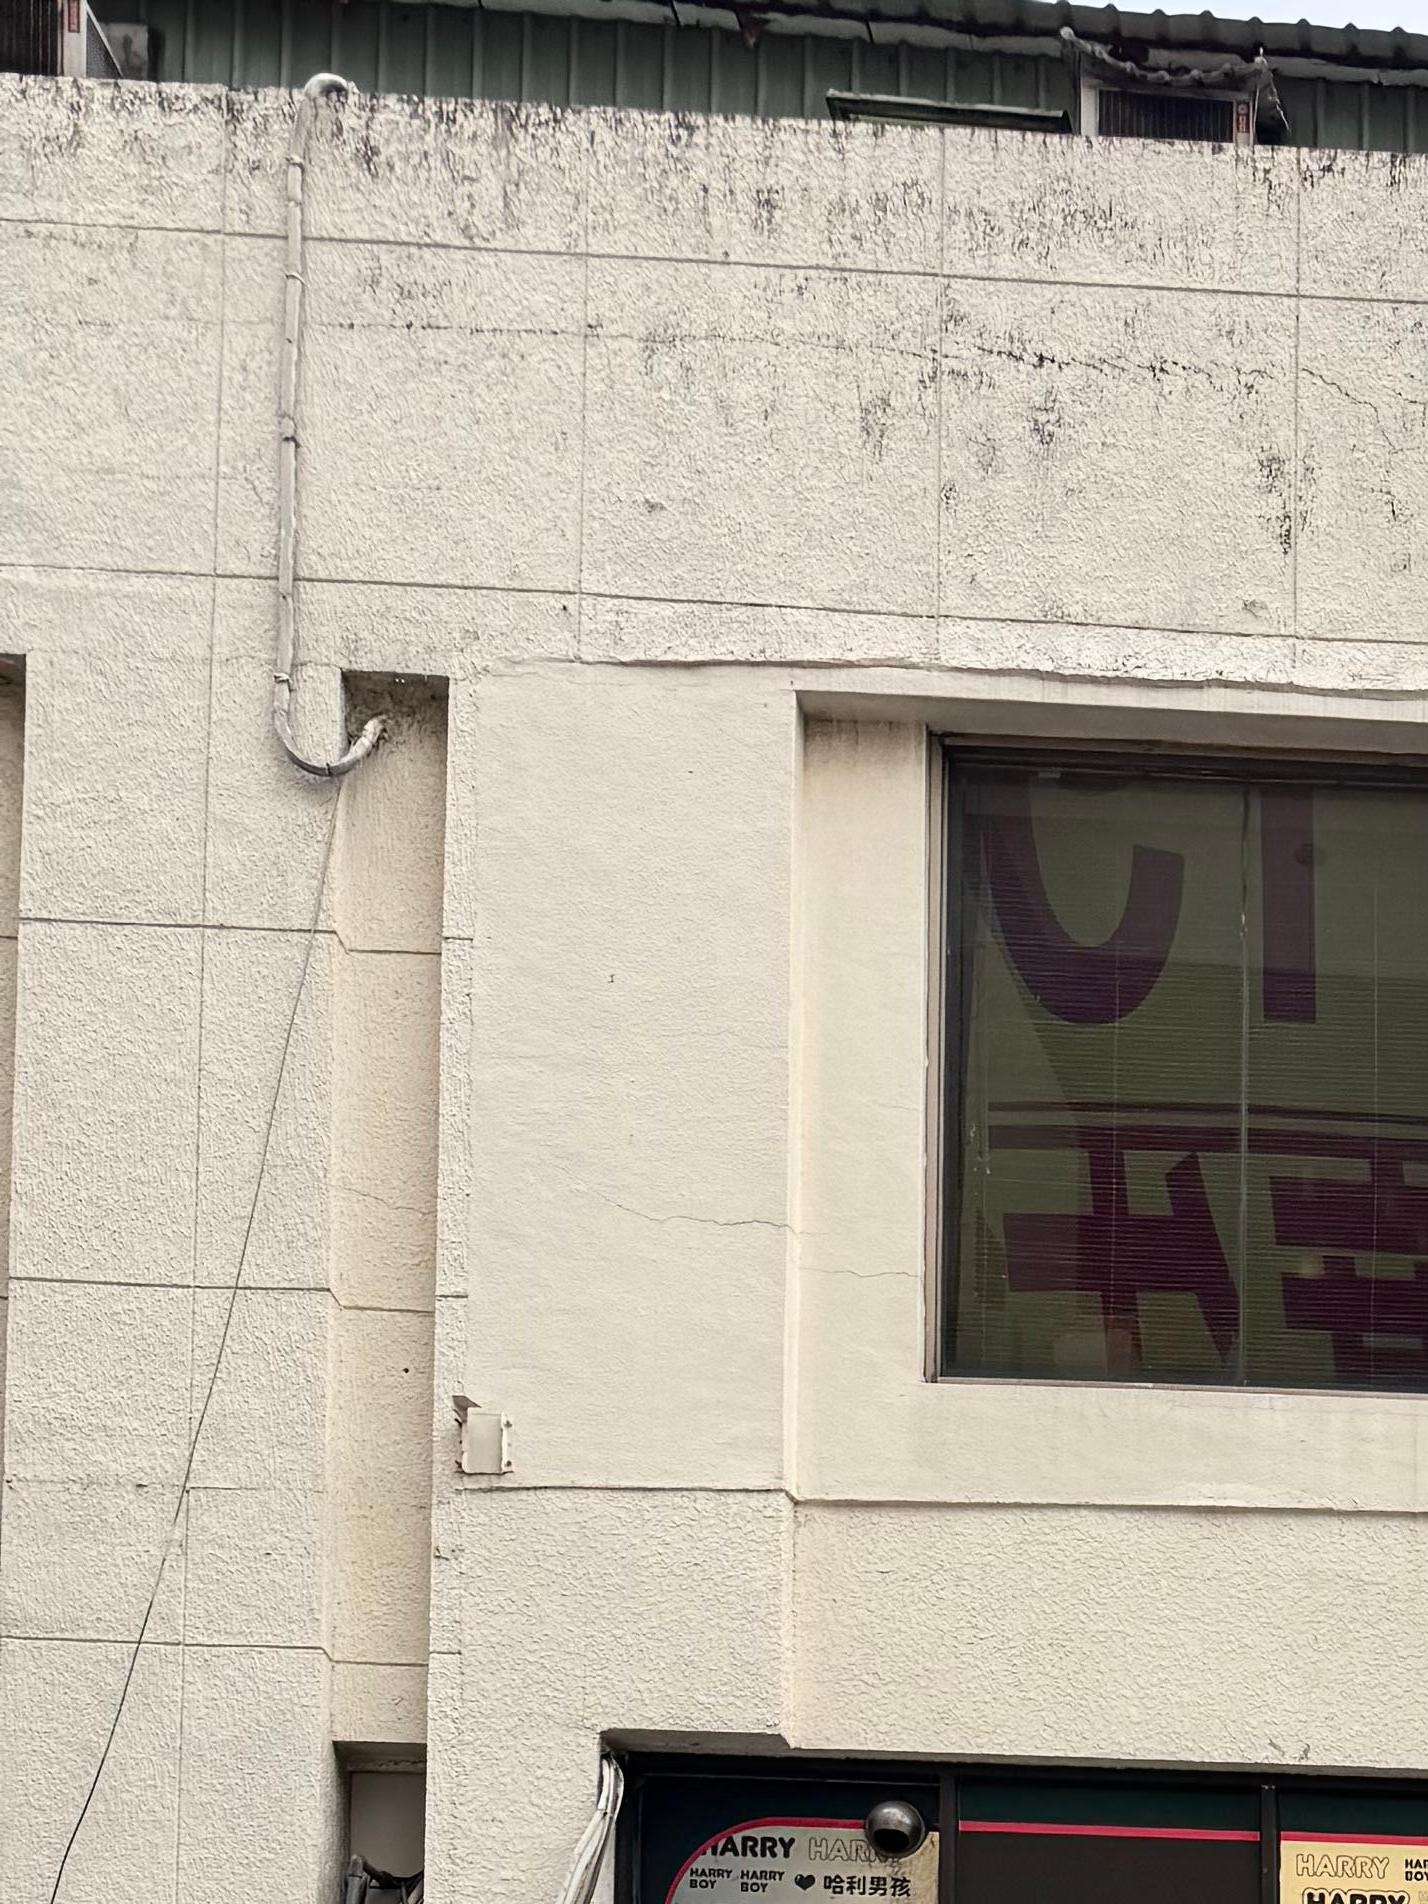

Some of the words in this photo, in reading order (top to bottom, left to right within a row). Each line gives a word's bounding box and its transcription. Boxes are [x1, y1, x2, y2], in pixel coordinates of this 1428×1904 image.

[1296, 1854, 1389, 1879] HARRY
[690, 1868, 732, 1879] HARRY
[740, 1870, 784, 1881] HARRY
[690, 1879, 716, 1888] BOY
[740, 1882, 768, 1893] BOY
[824, 1874, 911, 1897] 哈利男孩
